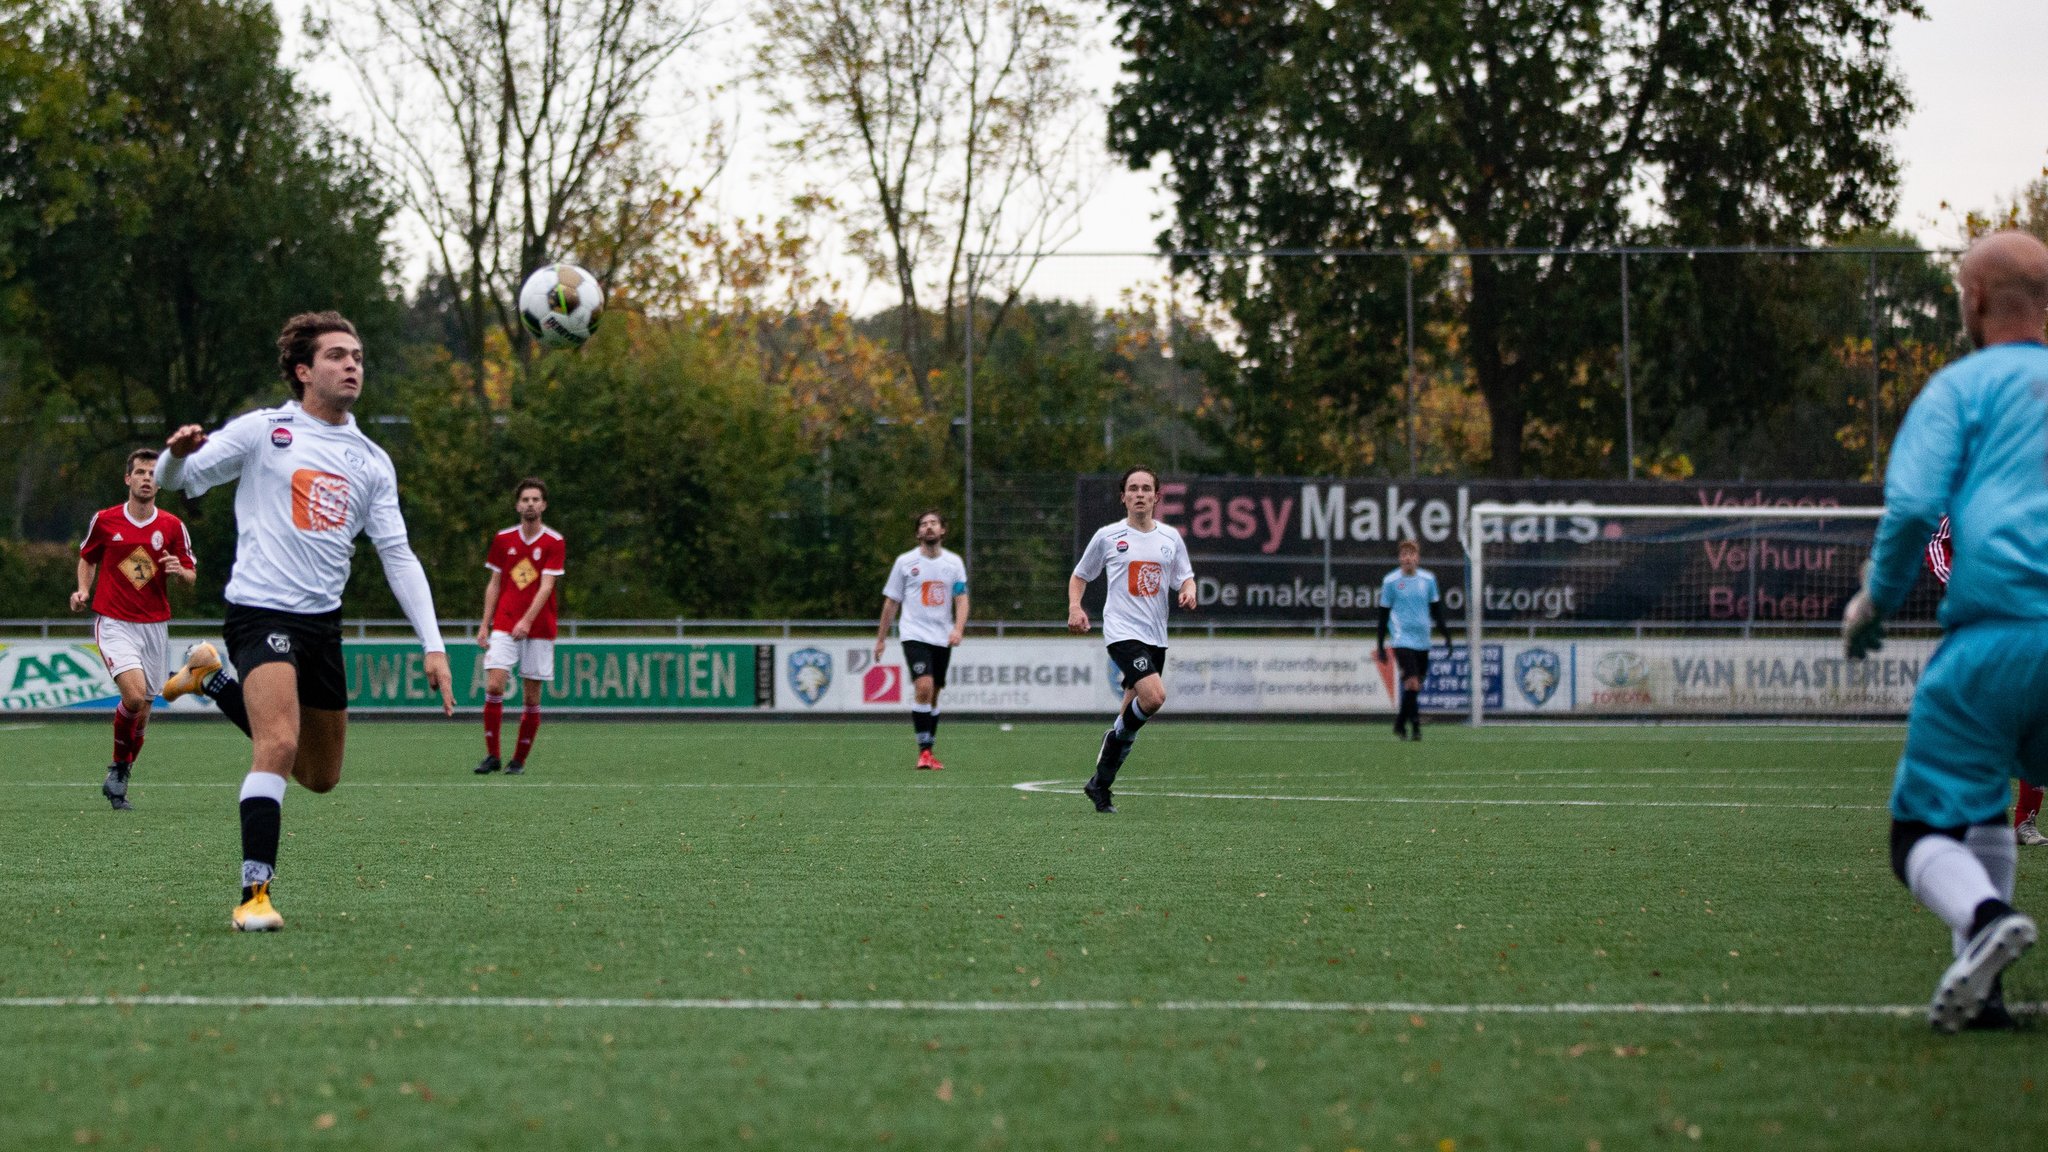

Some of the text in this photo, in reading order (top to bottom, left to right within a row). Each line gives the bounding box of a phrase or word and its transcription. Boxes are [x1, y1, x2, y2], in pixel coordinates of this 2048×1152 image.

[1704, 540, 1837, 572] Vehuur
[1200, 577, 1239, 606] De
[1444, 584, 1577, 619] otzorgt
[11, 652, 92, 692] AA
[469, 645, 737, 699] AURANTIËN
[950, 665, 1092, 686] IEBERGEN
[1672, 657, 1920, 688] VAN HAASTEREN
[3, 682, 105, 710] DRINK
